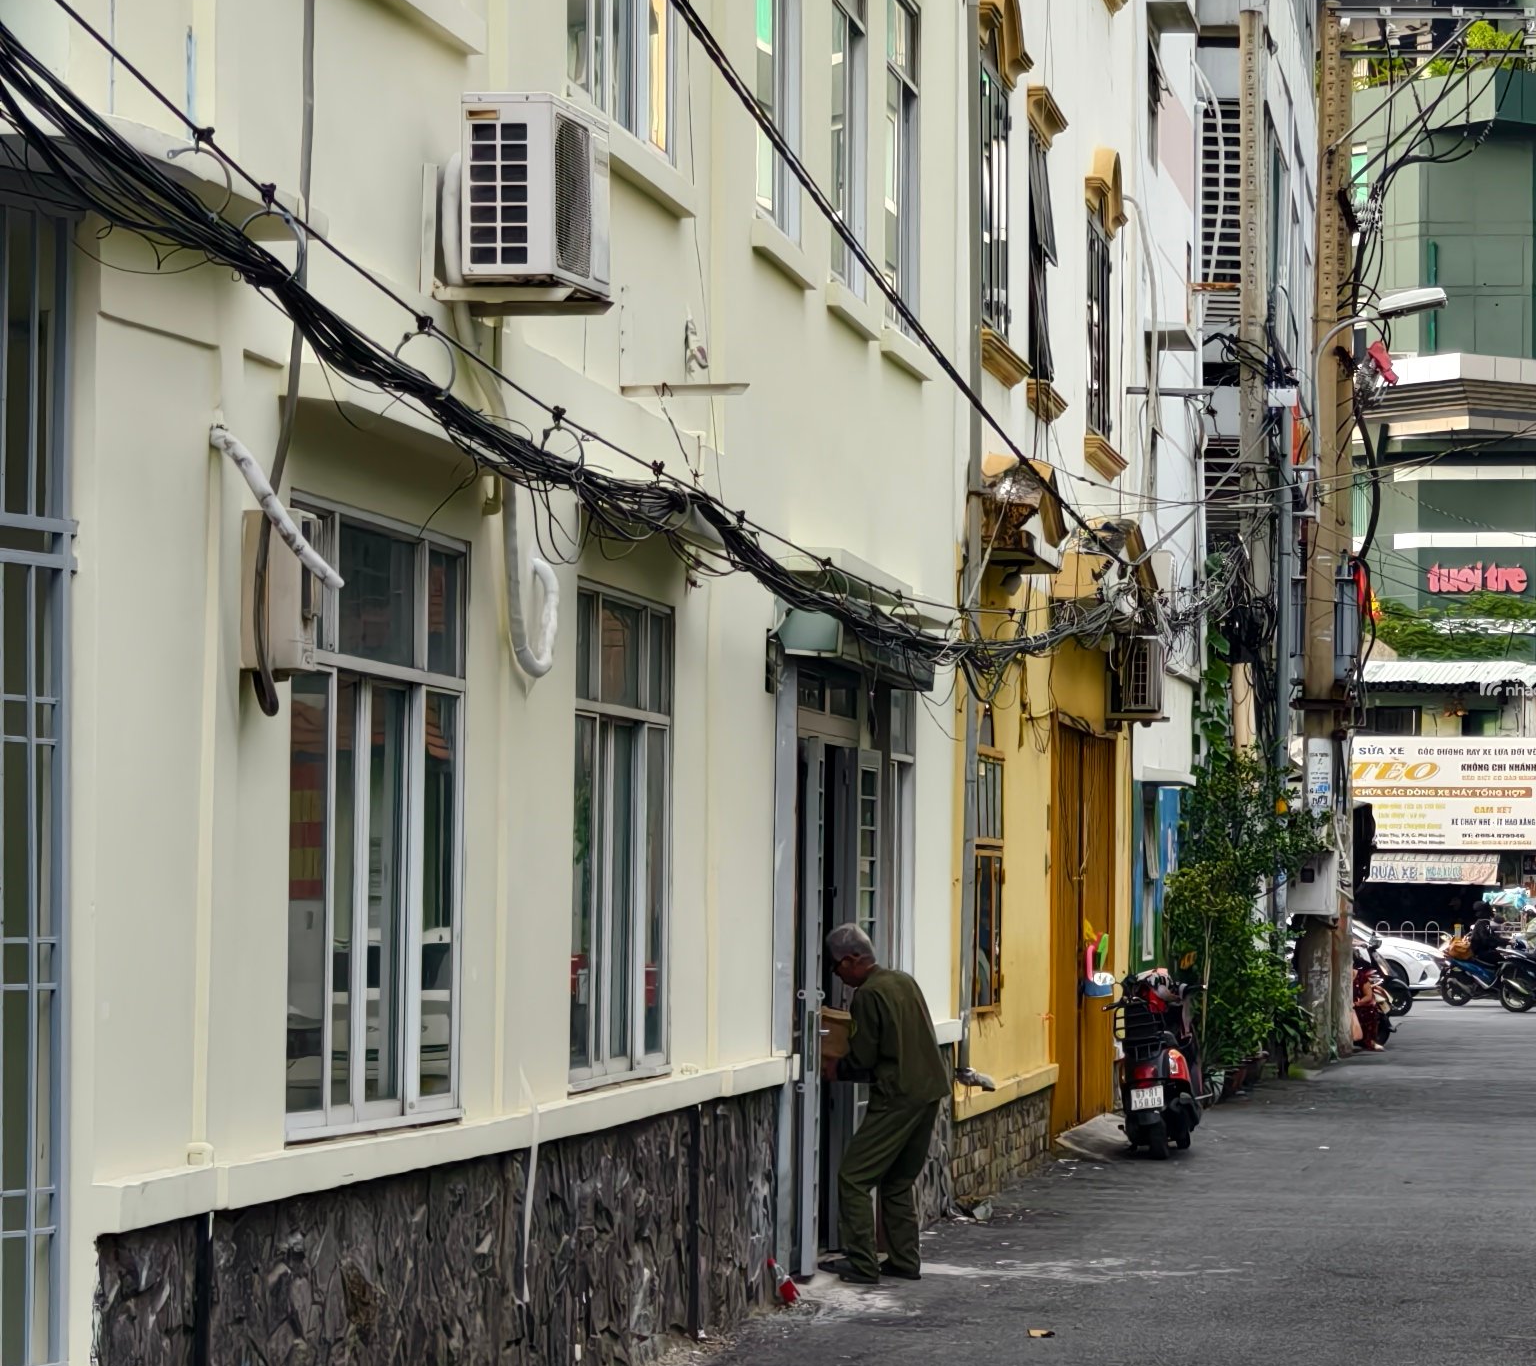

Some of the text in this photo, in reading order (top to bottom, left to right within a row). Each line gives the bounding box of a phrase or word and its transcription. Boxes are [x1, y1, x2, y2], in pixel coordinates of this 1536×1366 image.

[1389, 746, 1405, 756] XE
[1491, 763, 1506, 772] CHI
[1384, 787, 1406, 797] CÁC
[1438, 789, 1450, 797] XE
[1452, 787, 1474, 797] MÁY
[1401, 866, 1418, 879] XE
